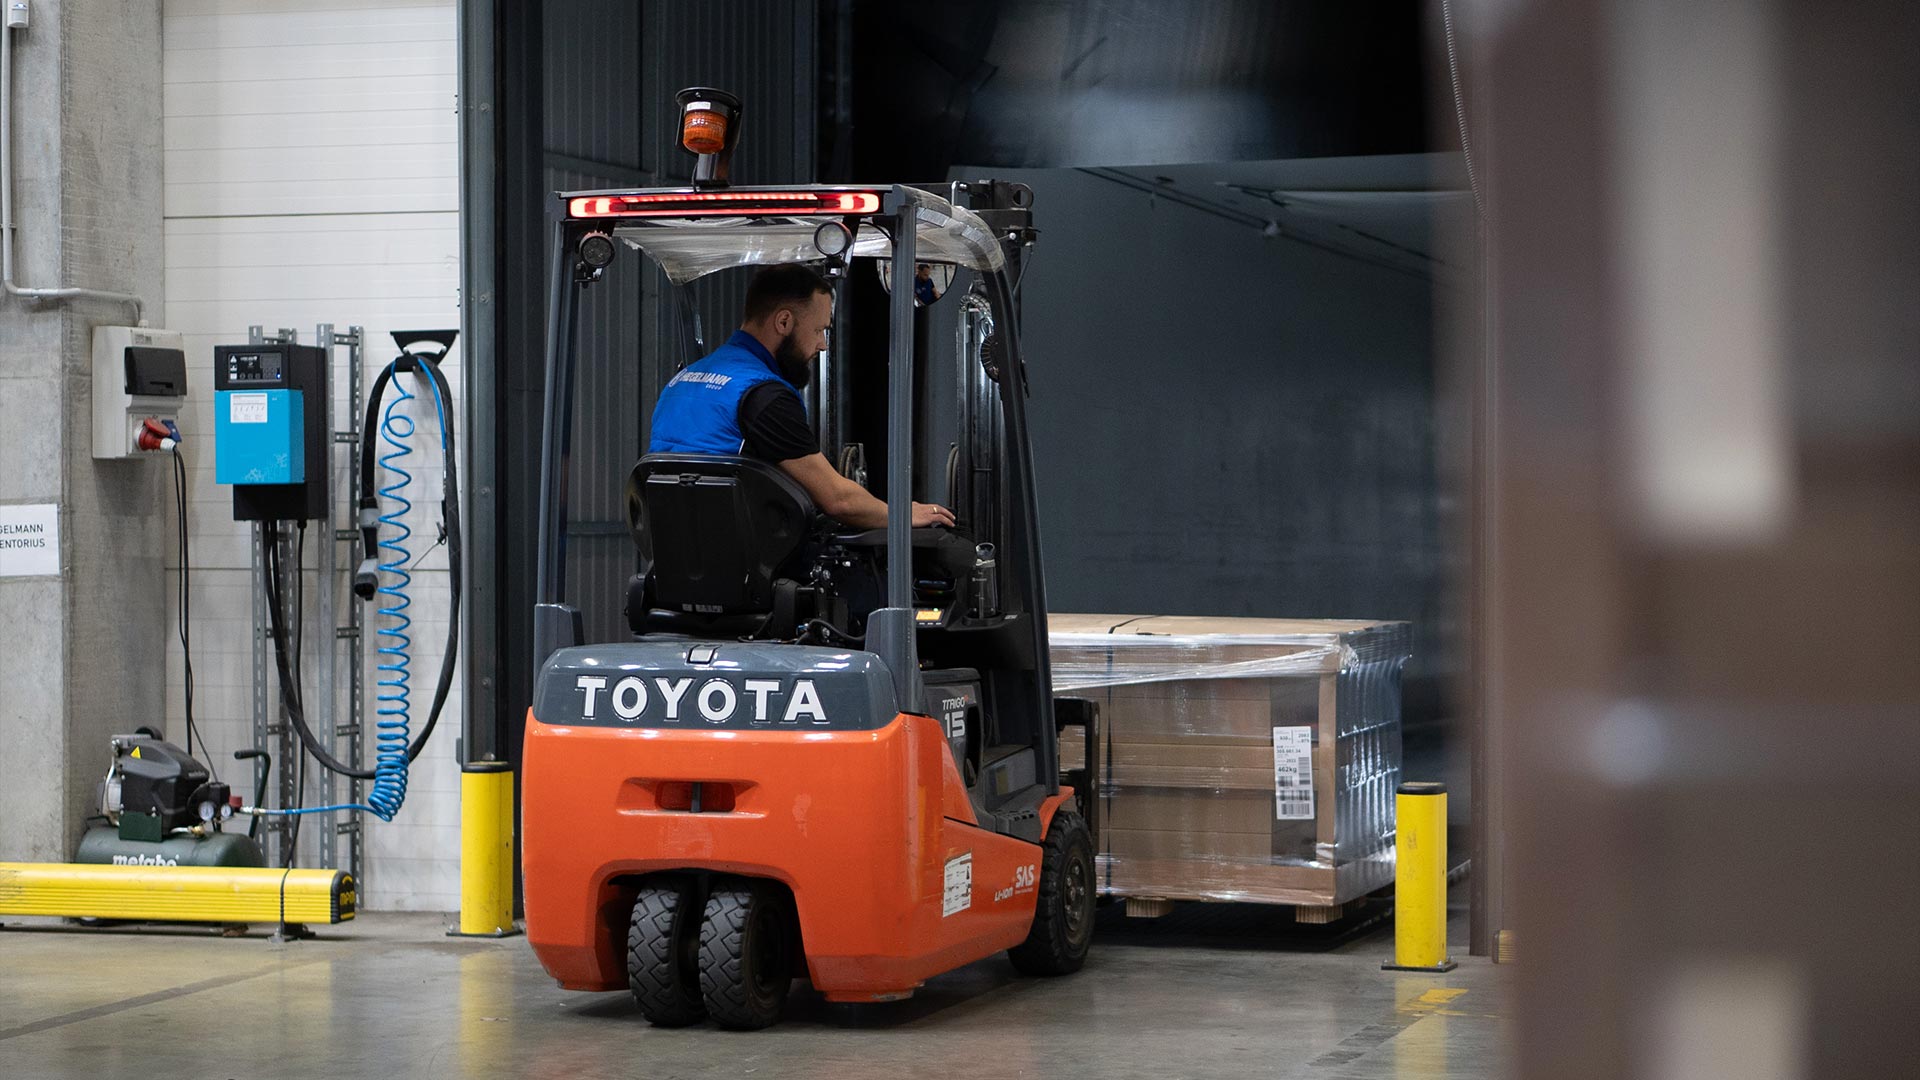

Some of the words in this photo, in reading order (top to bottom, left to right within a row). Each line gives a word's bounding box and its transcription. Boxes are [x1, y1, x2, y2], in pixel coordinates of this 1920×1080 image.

[575, 675, 829, 724] TOYOTA
[945, 711, 965, 738] 15
[1015, 864, 1035, 888] SAS
